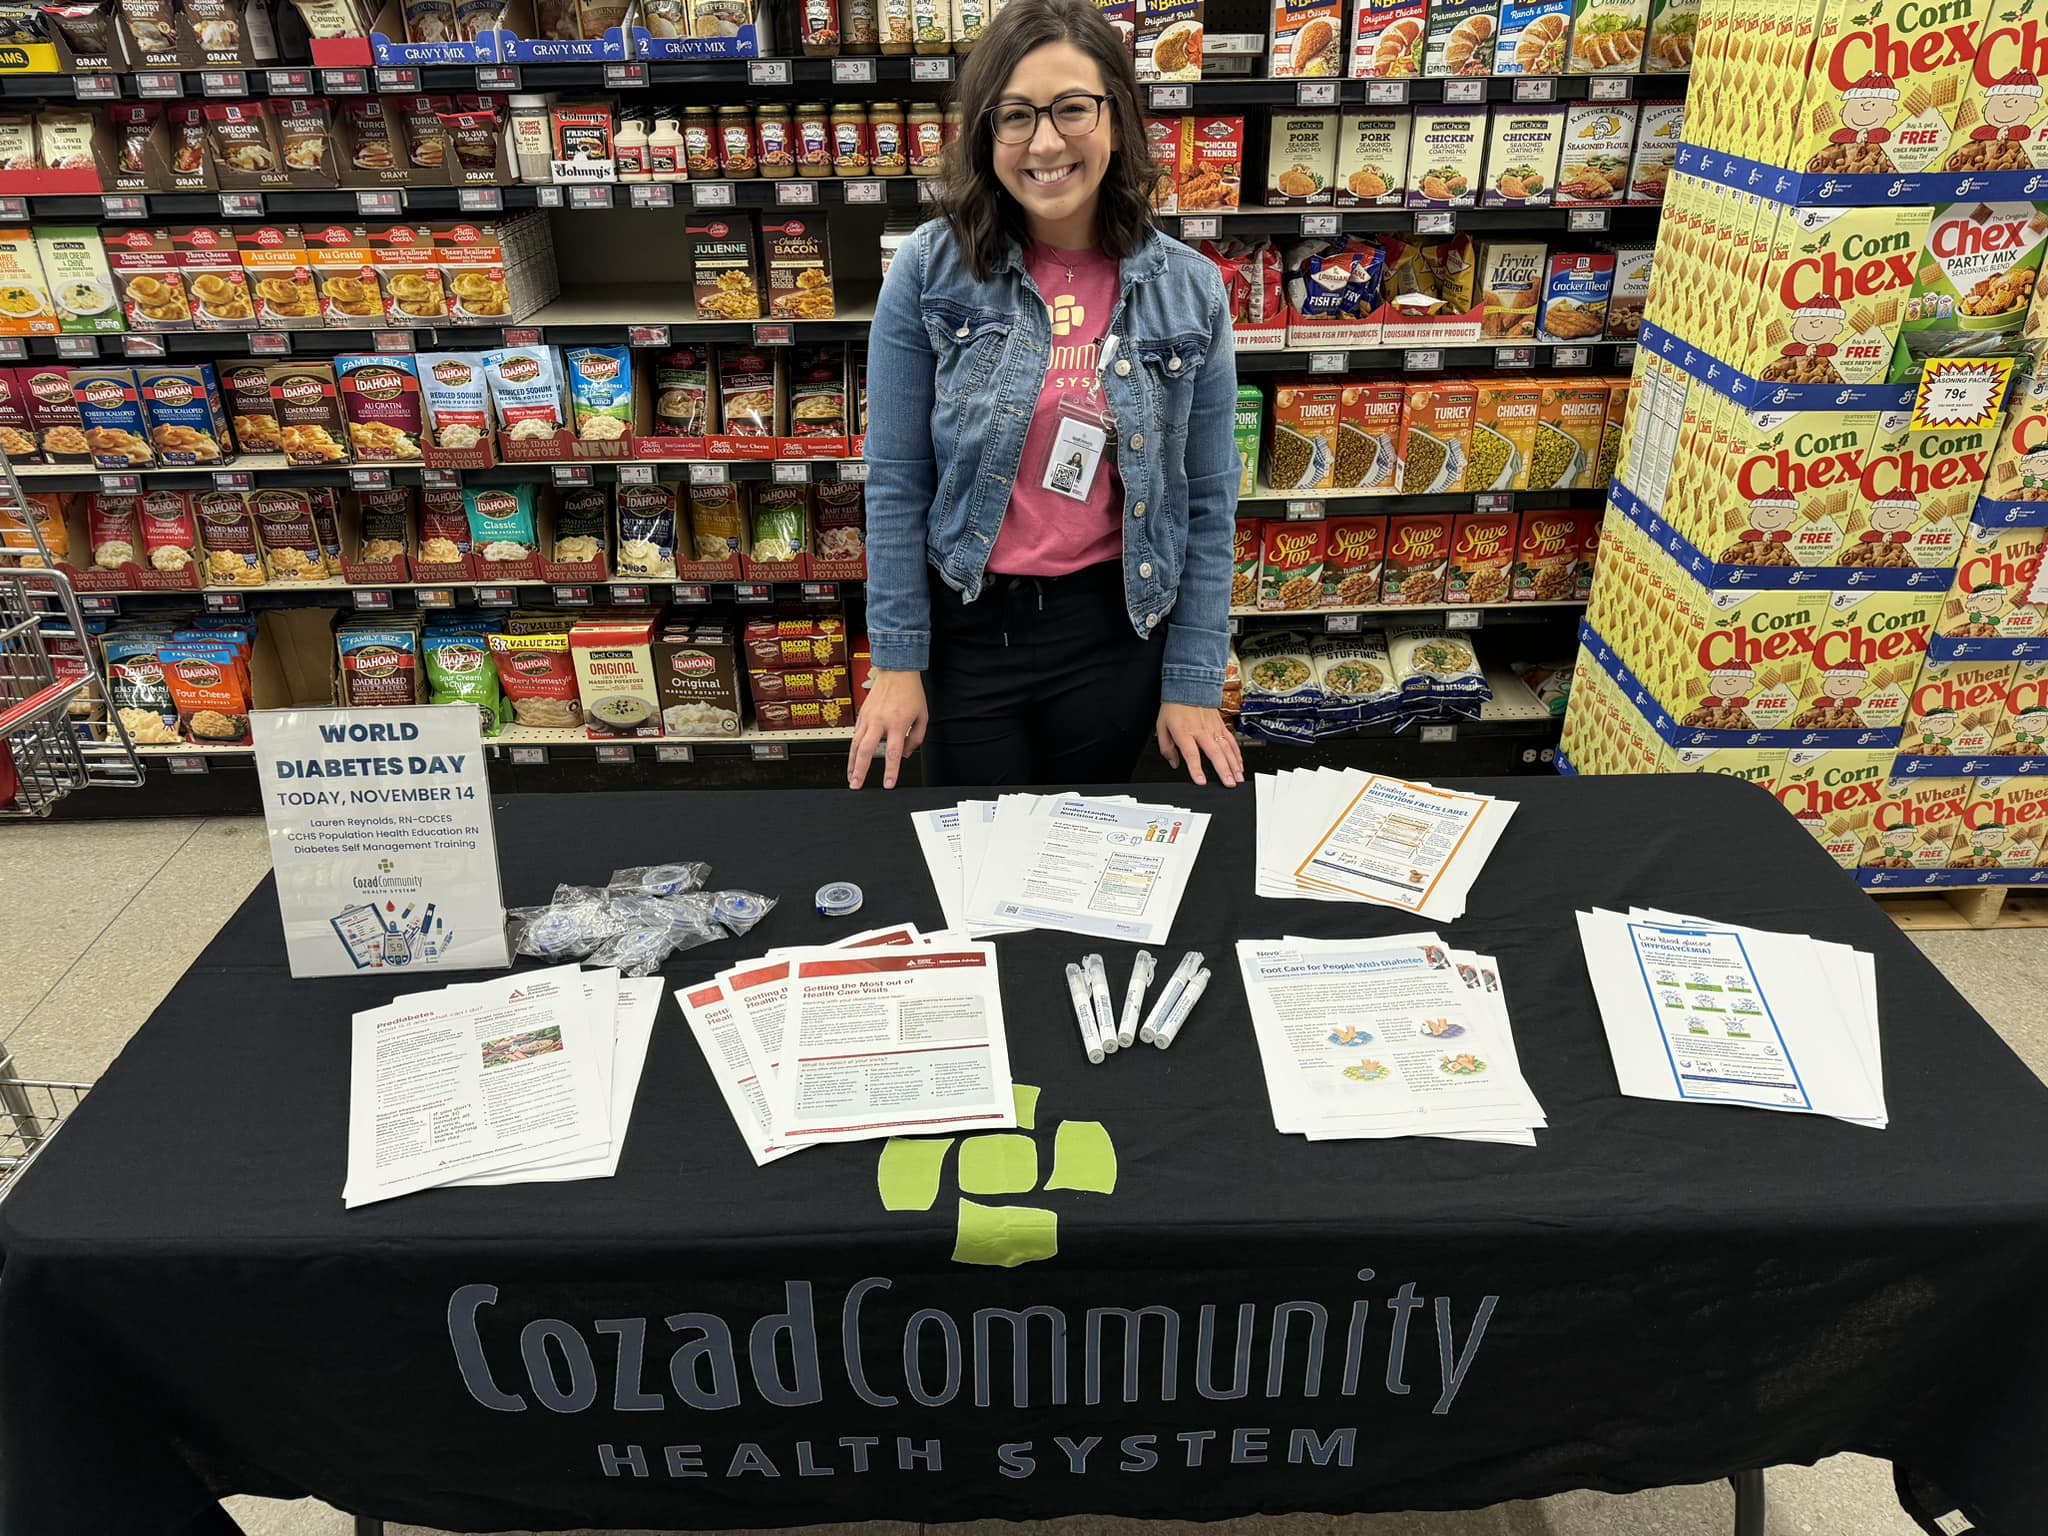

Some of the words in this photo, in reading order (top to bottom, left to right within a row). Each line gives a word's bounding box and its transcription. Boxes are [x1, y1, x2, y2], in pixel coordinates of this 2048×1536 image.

[1287, 13, 1305, 22] Extra
[1307, 8, 1331, 18] Crispy
[1895, 0, 1972, 33] Corn
[405, 49, 440, 58] GRAVY
[446, 48, 464, 58] MIX
[533, 45, 568, 55] GRAVY
[571, 44, 592, 54] MIX
[1827, 20, 1983, 92] Chex
[76, 58, 108, 66] GRAVY
[147, 54, 177, 63] GRAVY
[207, 53, 238, 61] GRAVY
[1290, 134, 1319, 142] PORK
[1361, 133, 1391, 142] PORK
[1425, 134, 1474, 143] CHICKEN
[1503, 133, 1552, 142] CHICKEN
[1899, 130, 1938, 144] FREE
[1567, 142, 1604, 151] SEASONED
[1606, 142, 1629, 151] FLOUR
[556, 166, 611, 178] Johnny's
[2006, 212, 2028, 220] Original
[1842, 229, 1911, 259] Corn
[1932, 220, 2029, 258] Chex
[319, 251, 331, 259] Au
[333, 251, 363, 259] Gratin
[695, 244, 747, 254] JULIENNE
[775, 244, 818, 255] BACON
[251, 252, 264, 260] Au
[266, 252, 296, 260] Gratin
[1500, 252, 1538, 268] Fryin'
[1947, 254, 1987, 270] PARTY
[1993, 250, 2017, 263] MIX
[1491, 269, 1537, 282] MAGIC
[1778, 251, 1922, 310] Chex
[1553, 281, 1584, 291] Cracker
[1586, 280, 1609, 291] Meal
[1310, 297, 1328, 306] FISH
[1237, 336, 1249, 344] FRY
[1250, 335, 1281, 344] PRODUCTS
[1291, 331, 1321, 339] LOUISIANA
[1322, 330, 1337, 339] FISH
[1339, 330, 1348, 338] FRY
[1350, 329, 1378, 338] PRODUCTS
[1845, 345, 1881, 358] FREE
[343, 358, 379, 370] FAMILY
[382, 358, 408, 370] SIZE
[356, 377, 401, 391] IDAHOAN
[86, 389, 124, 402] IDAHOAN
[154, 386, 192, 399] IDAHOAN
[283, 386, 322, 398] IDAHOAN
[1944, 388, 1967, 399] 79¢
[1300, 404, 1336, 418] TURKEY
[1365, 403, 1400, 415] TURKEY
[1435, 406, 1471, 419] TURKEY
[1497, 404, 1537, 417] CHICKEN
[506, 441, 528, 449] 100%
[530, 440, 558, 448] IDAHO
[1795, 430, 1858, 458] Corn
[1919, 421, 1983, 459] Corn
[429, 452, 450, 460] 100%
[453, 451, 482, 459] IDAHO
[508, 447, 561, 457] POTATOES
[571, 442, 629, 456] NEW!
[430, 459, 484, 468] POTATOES
[1736, 447, 1869, 501] Chex
[1859, 447, 1991, 502] Chex
[483, 521, 516, 529] Classic
[1328, 526, 1377, 557] Stove
[1392, 525, 1443, 555] Stove
[1456, 523, 1508, 554] Stove
[1799, 532, 1832, 545] FREE
[1919, 532, 1952, 545] FREE
[1269, 530, 1318, 562] Stove
[1285, 549, 1310, 568] Top
[1345, 544, 1370, 562] Top
[1867, 608, 1926, 634] Corn
[1327, 651, 1377, 660] STUFFING
[590, 662, 638, 675] ORIGINAL
[381, 677, 406, 685] BAKED
[1957, 664, 2010, 687] Wheat
[672, 679, 721, 689] Original
[176, 689, 196, 697] Four
[199, 690, 231, 698] Cheese
[319, 722, 419, 743] WORLD
[276, 757, 404, 779] DIABETES
[408, 755, 466, 775] DAY
[277, 791, 346, 806] TODAY,
[351, 788, 450, 804] NOVEMBER
[455, 786, 475, 800] 14
[1372, 781, 1407, 798] Reading
[1916, 784, 1967, 804] Wheat
[1368, 789, 1413, 805] NUTRITION
[1413, 800, 1442, 810] FACTS
[1442, 806, 1469, 817] LABEL
[1060, 811, 1092, 820] Nutrition
[1061, 806, 1115, 818] Understanding
[310, 818, 345, 828] Lauren
[347, 817, 397, 828] Reynolds,
[399, 815, 452, 823] RN-CDCES
[287, 833, 317, 841] CCHS
[319, 830, 374, 842] Population
[376, 829, 409, 838] Health
[411, 827, 463, 836] Education
[294, 844, 340, 854] Diabetes
[342, 843, 360, 852] Self
[362, 841, 431, 853] Management
[434, 839, 476, 850] Training
[1108, 866, 1132, 874] Calories
[353, 875, 422, 889] CozadCommunity
[1638, 933, 1657, 943] Low
[1659, 936, 1680, 946] blood
[1681, 939, 1712, 950] glucose
[1641, 942, 1711, 955] (HYPOGLYCEMIA)
[1260, 966, 1282, 975] Foot
[1284, 965, 1306, 973] Care
[1323, 962, 1355, 971] People
[1356, 960, 1379, 969] With
[1380, 956, 1424, 967] Diabetes
[804, 984, 840, 993] Getting
[803, 991, 835, 1000] Health
[376, 1010, 434, 1029] Prediabetes
[445, 1268, 1501, 1415] CozadCommunity
[596, 1436, 944, 1479] HEALTH
[997, 1425, 1358, 1479] SYSTEM
